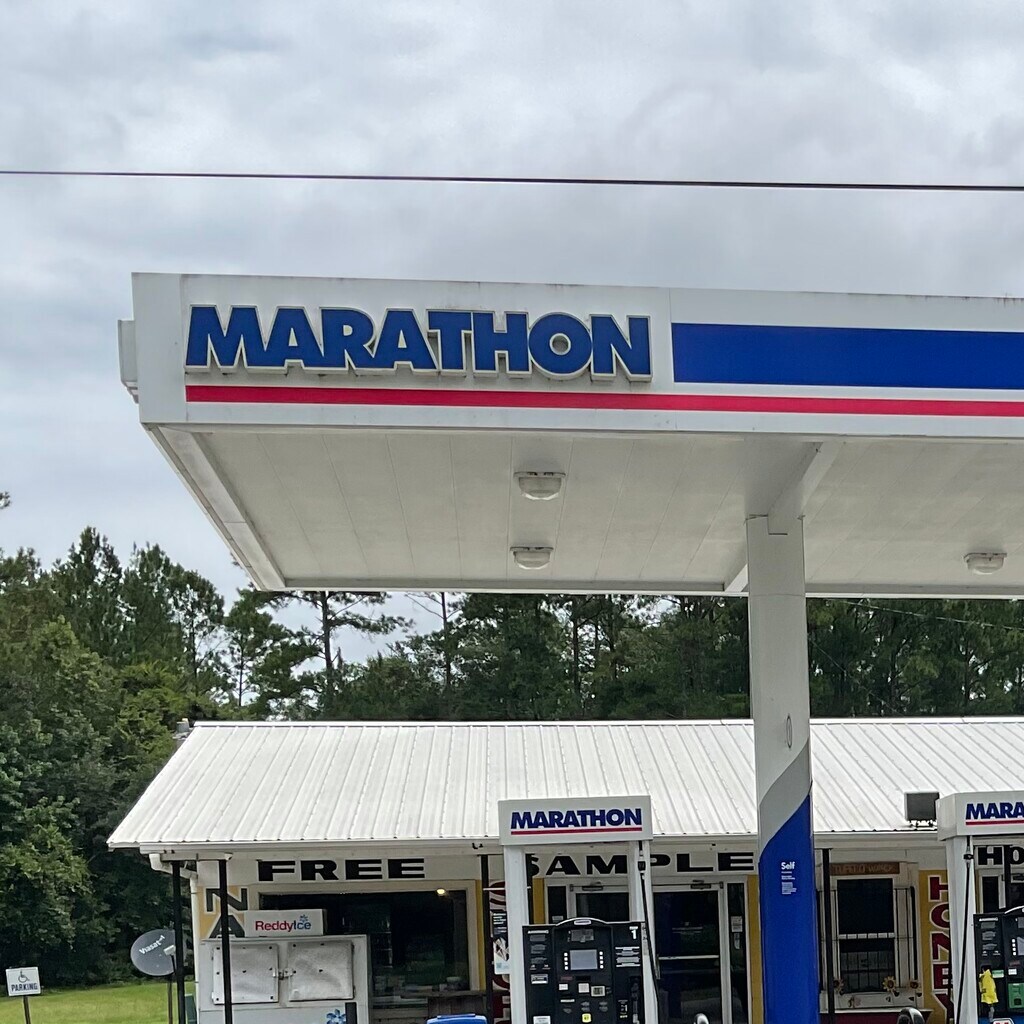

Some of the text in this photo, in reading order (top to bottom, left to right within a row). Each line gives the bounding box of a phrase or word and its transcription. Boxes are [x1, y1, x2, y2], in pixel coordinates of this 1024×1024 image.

[185, 304, 653, 380] MARATHON
[510, 808, 642, 830] MARATHON
[257, 857, 426, 882] FREE
[780, 861, 796, 870] Self
[255, 919, 312, 933] ReddyIce
[11, 982, 38, 993] PARKING
